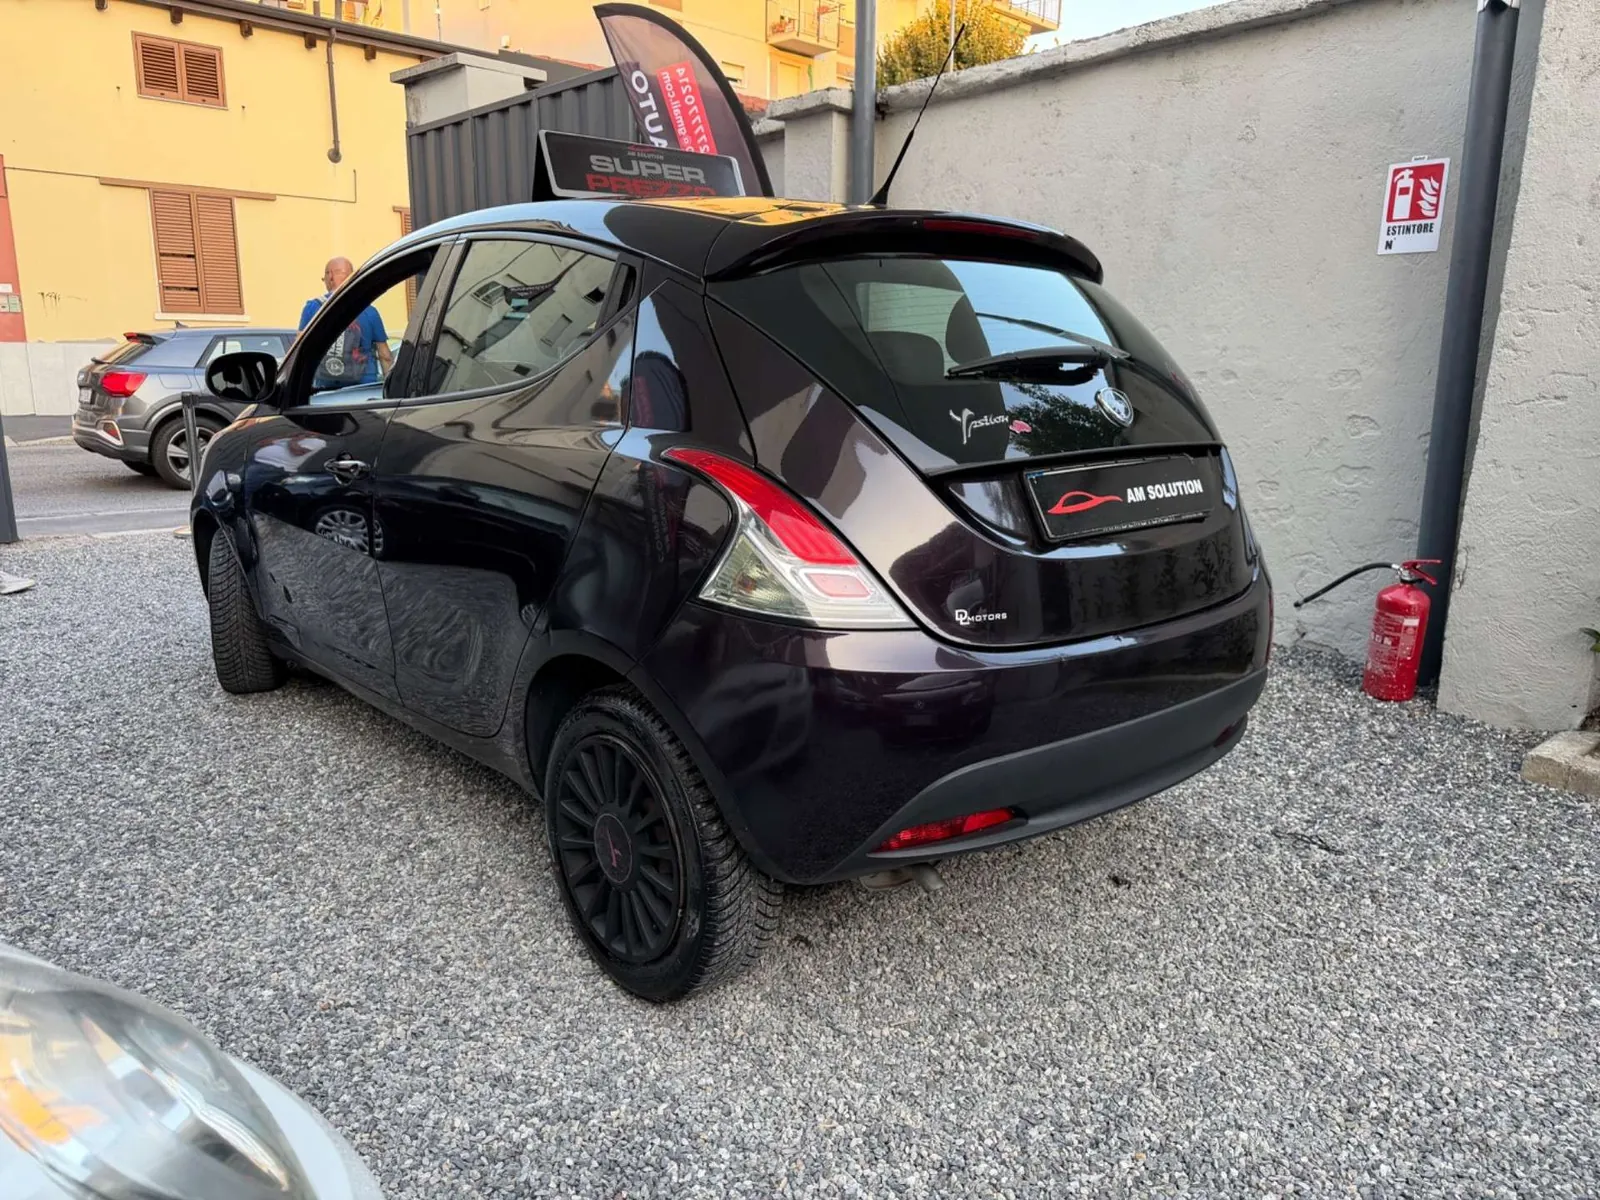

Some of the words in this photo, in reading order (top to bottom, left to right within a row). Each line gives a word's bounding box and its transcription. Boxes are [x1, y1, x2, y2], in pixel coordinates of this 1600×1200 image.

[589, 154, 706, 184] SUPER
[1386, 222, 1435, 237] ESTINTORE
[949, 407, 1009, 445] Ypsilon
[1127, 486, 1146, 504] AM
[1146, 478, 1204, 500] SOLUTION
